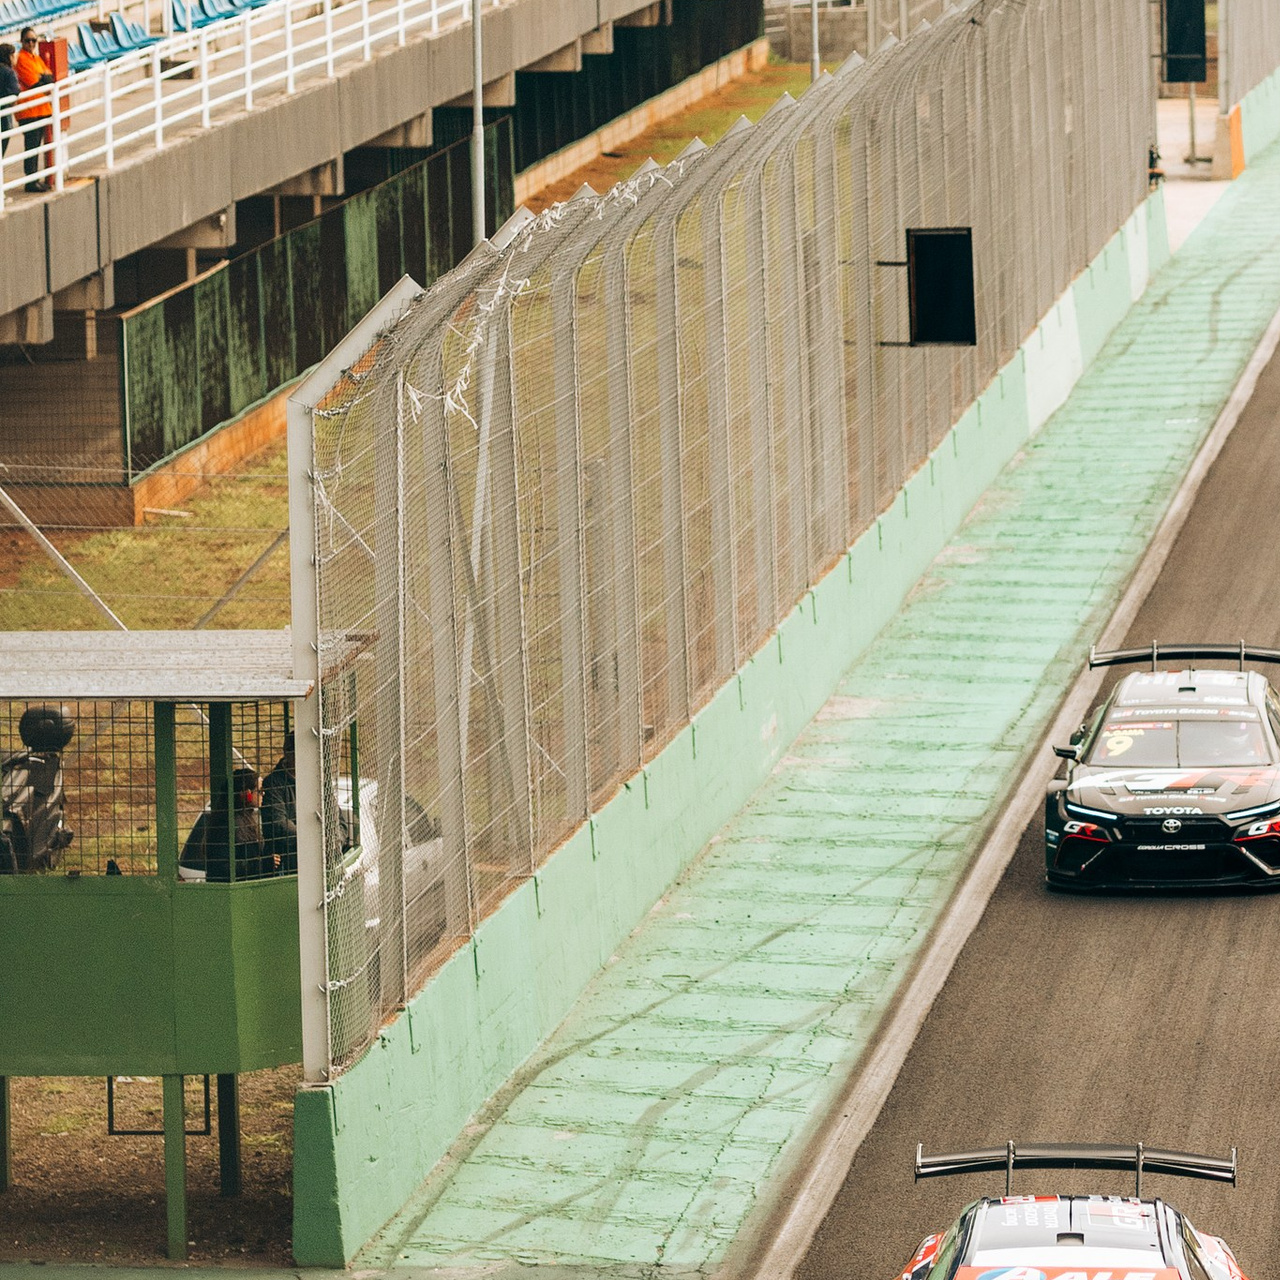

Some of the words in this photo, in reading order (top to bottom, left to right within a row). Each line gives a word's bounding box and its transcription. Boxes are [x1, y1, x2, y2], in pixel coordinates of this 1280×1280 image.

[1135, 708, 1178, 716] TOYOTA
[1106, 736, 1134, 757] 9
[1143, 806, 1204, 815] TOYOTA
[1063, 821, 1098, 836] GR
